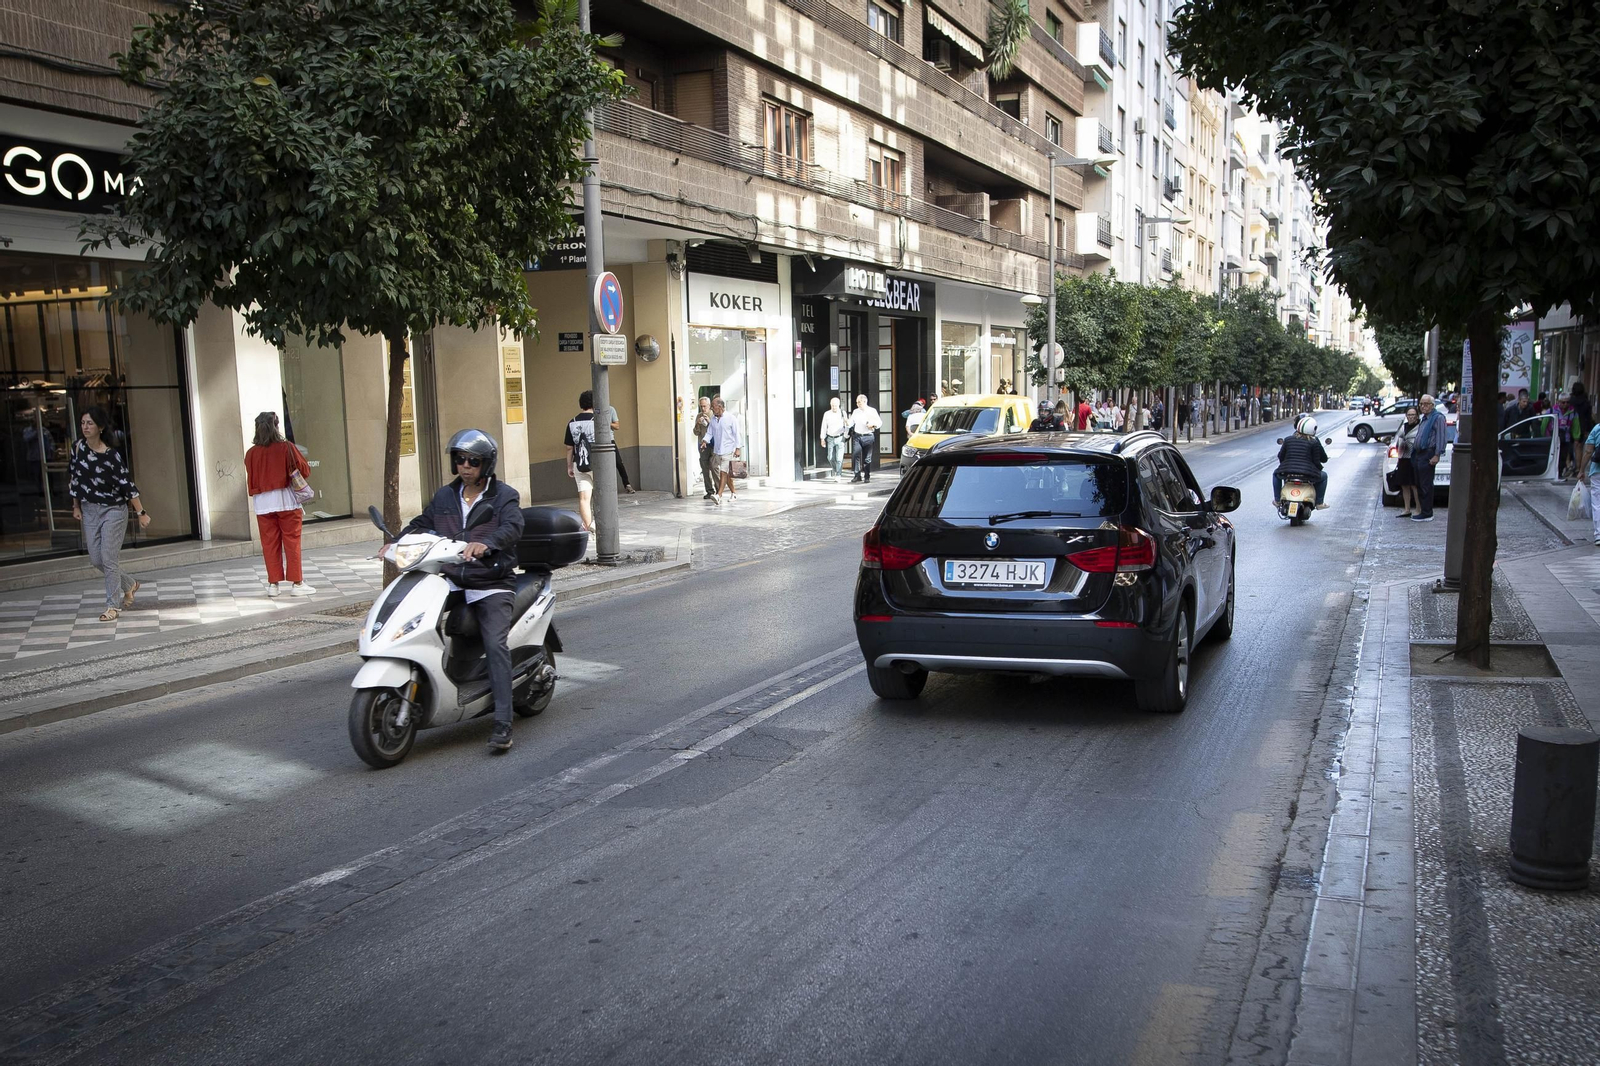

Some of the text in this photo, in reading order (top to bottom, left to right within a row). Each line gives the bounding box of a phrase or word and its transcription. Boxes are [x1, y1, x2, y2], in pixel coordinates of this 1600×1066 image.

[3, 146, 144, 200] GO MA
[550, 242, 586, 251] VERON
[569, 255, 587, 263] Plant
[848, 267, 886, 293] HOTEL
[710, 291, 763, 311] KOKER
[859, 278, 920, 311] &BEAR
[802, 303, 815, 317] TEL
[957, 563, 1040, 581] 3274 HJK
